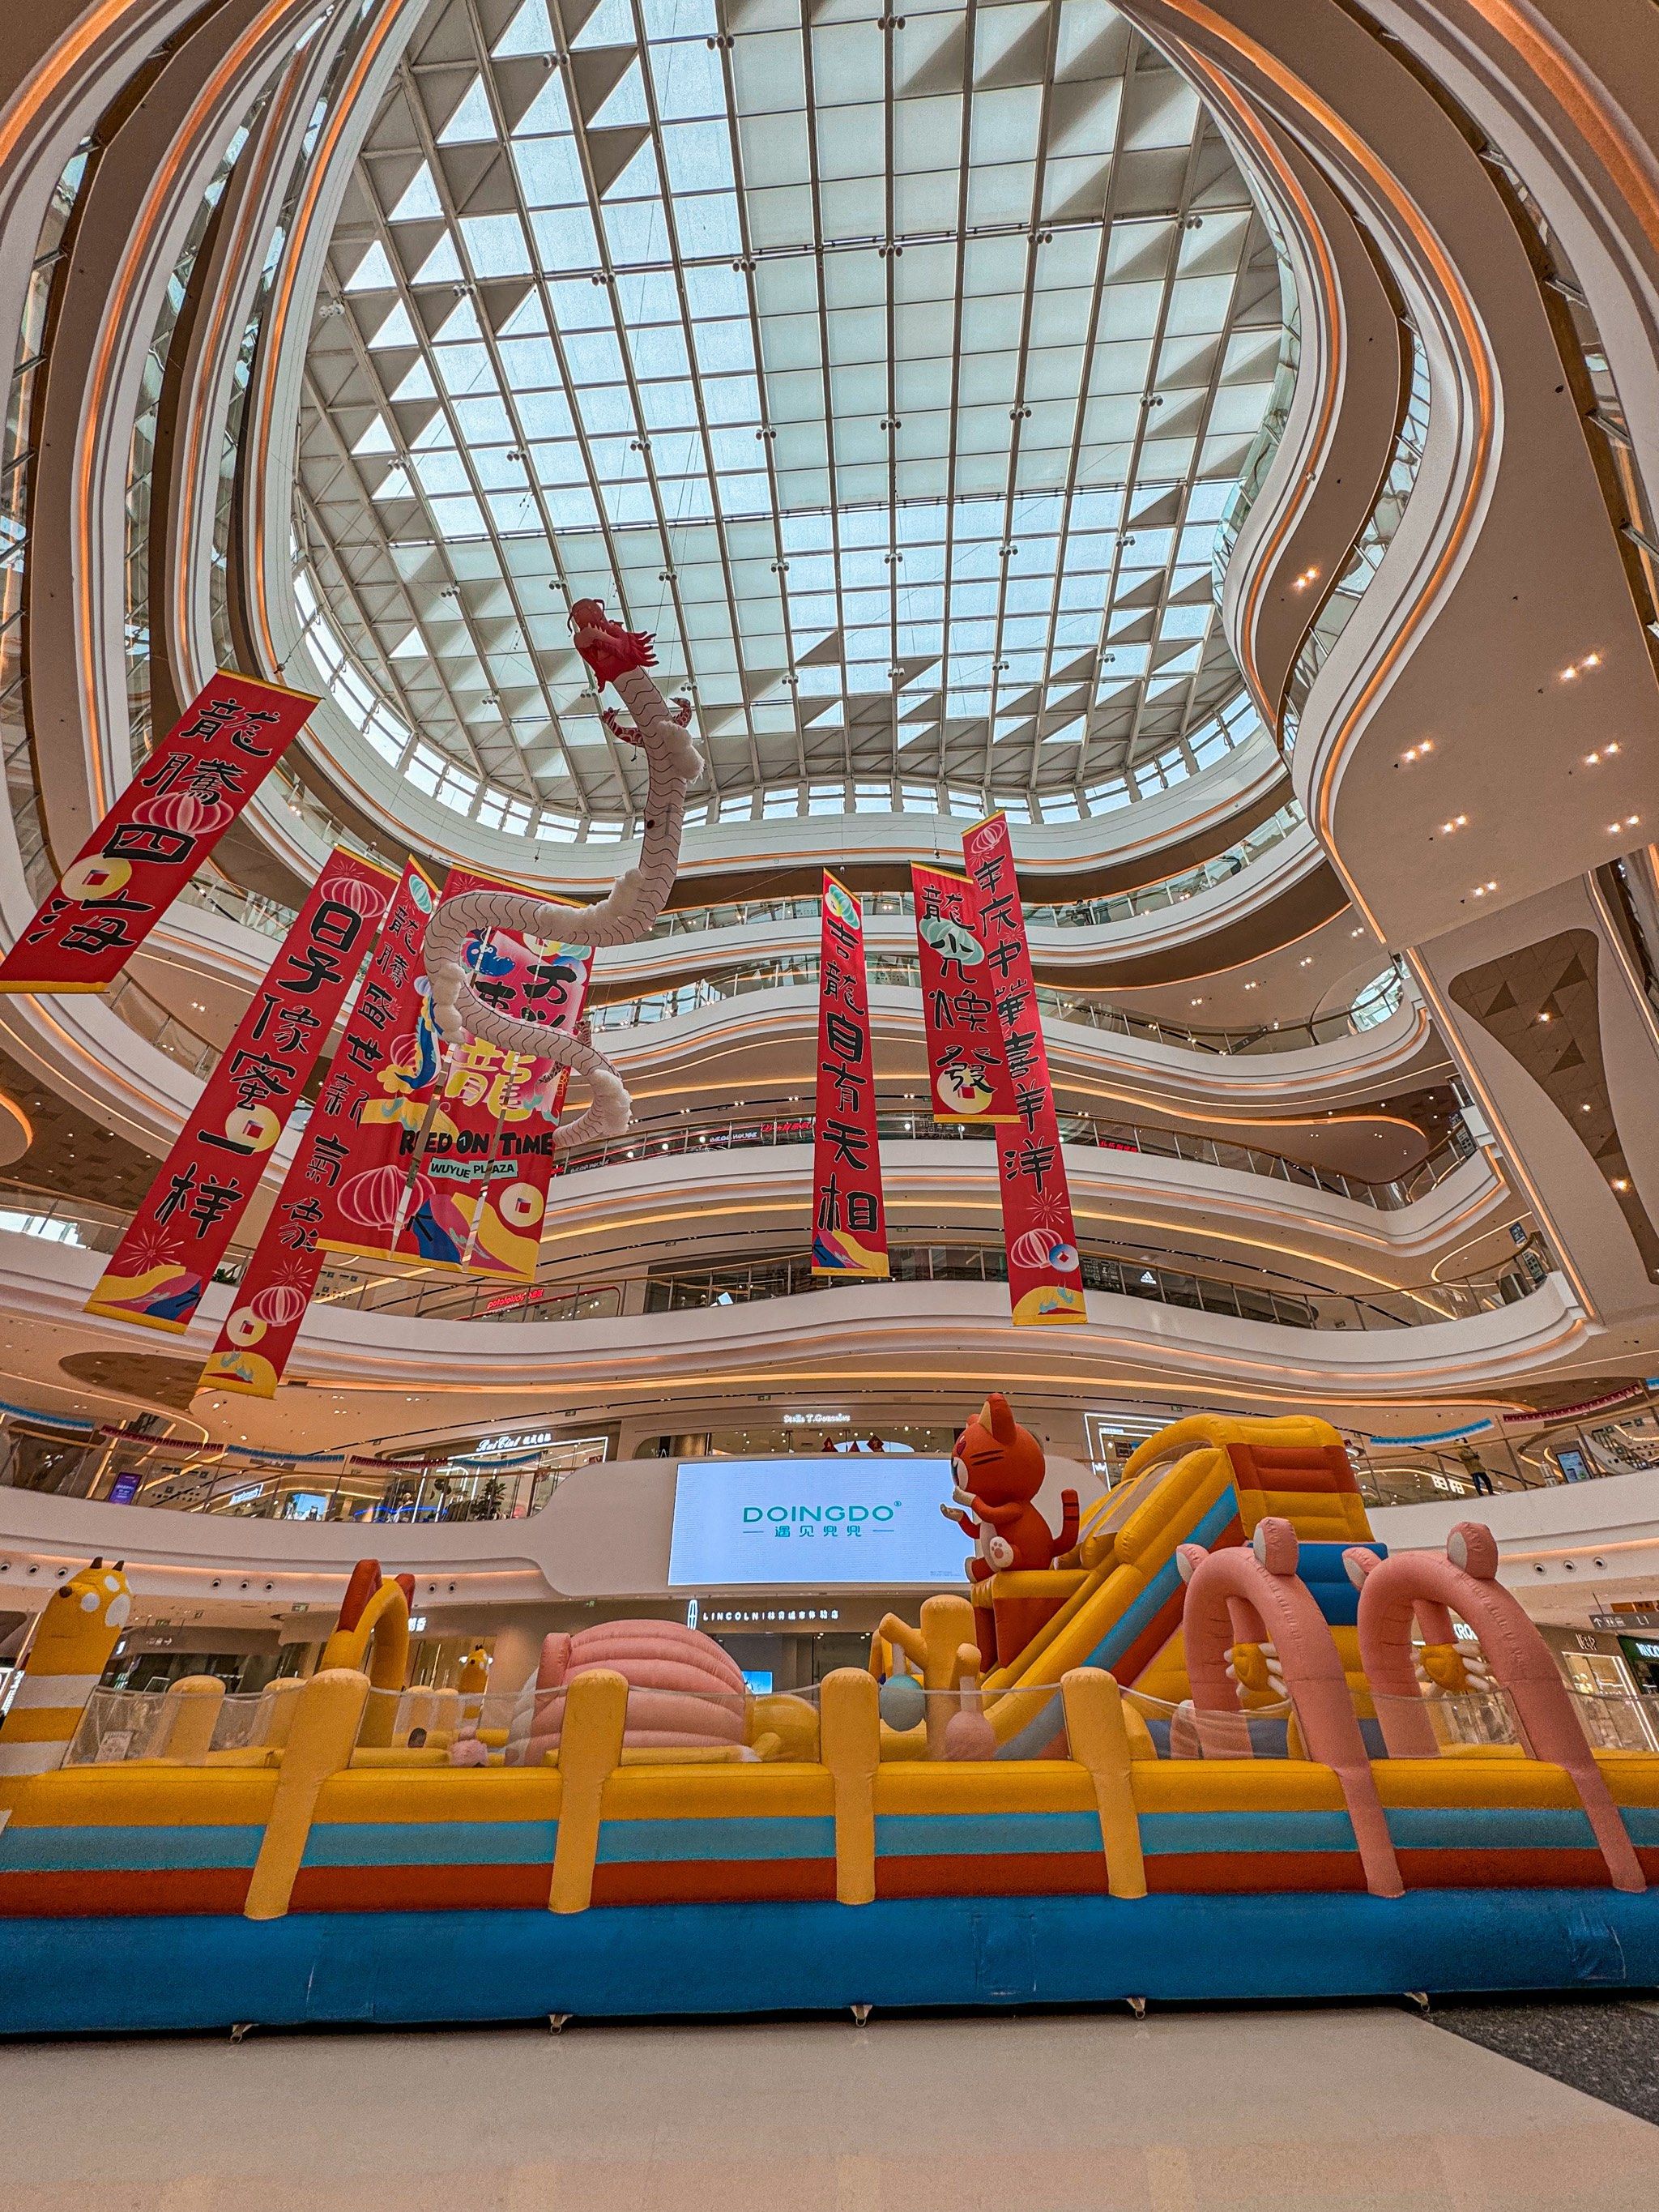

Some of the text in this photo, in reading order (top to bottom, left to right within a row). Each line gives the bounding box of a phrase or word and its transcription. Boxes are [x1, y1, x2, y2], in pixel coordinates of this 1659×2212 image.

[26, 698, 281, 955] 龍騰四海
[399, 1129, 553, 1156] RED ON TIME
[430, 1163, 515, 1179] WUYUE PLAZA
[702, 1612, 759, 1621] LINCOLN
